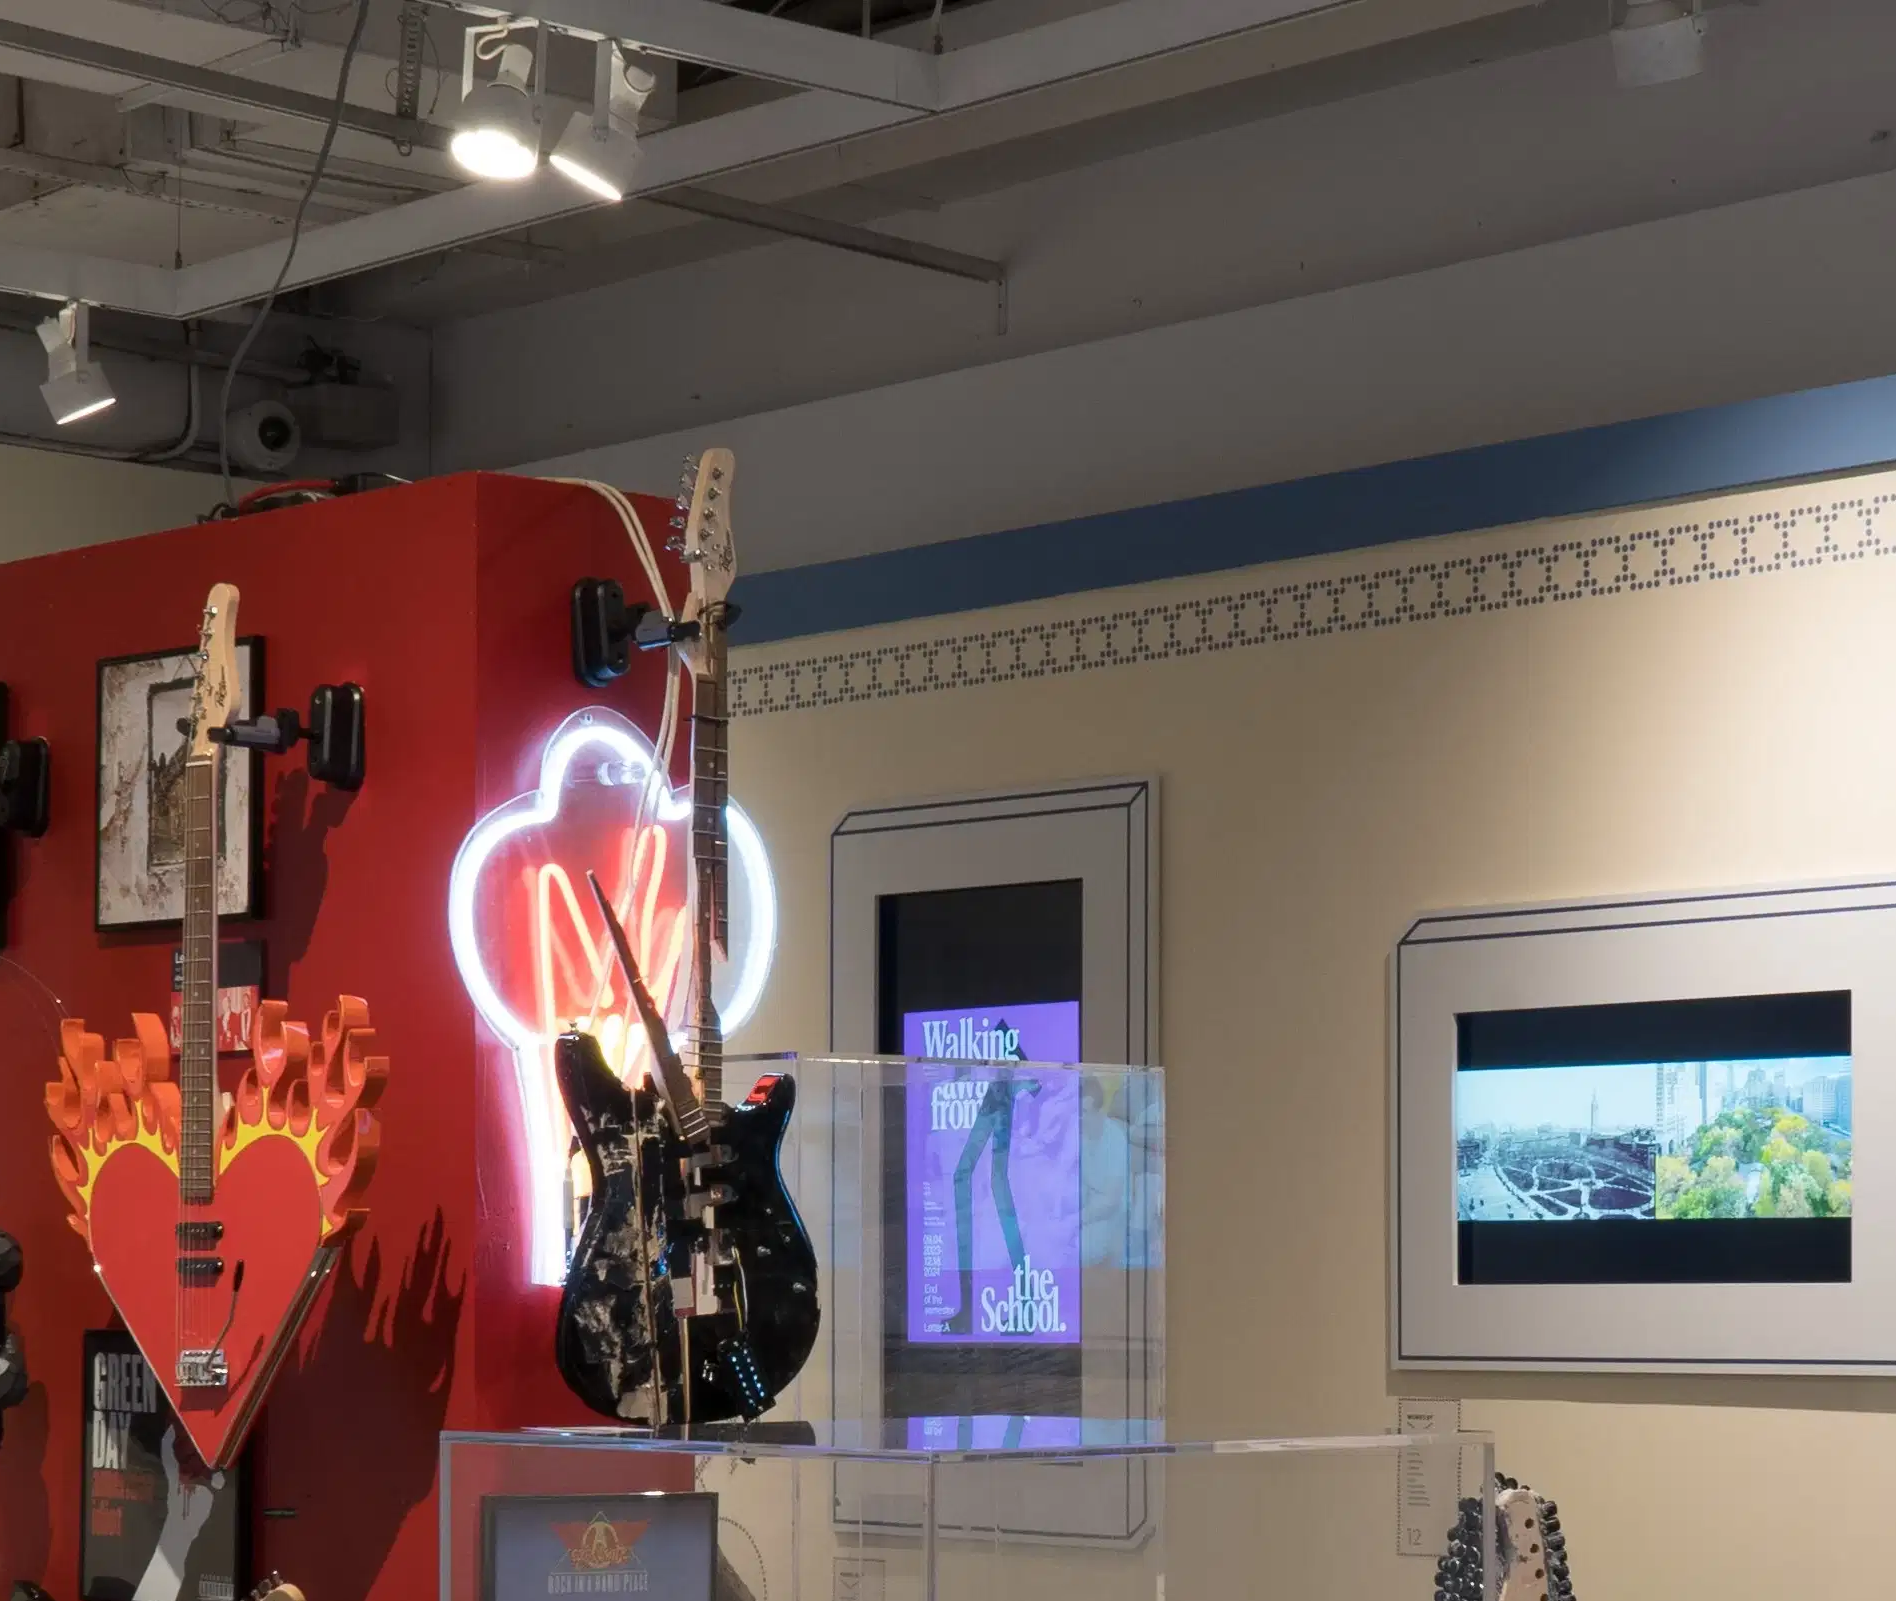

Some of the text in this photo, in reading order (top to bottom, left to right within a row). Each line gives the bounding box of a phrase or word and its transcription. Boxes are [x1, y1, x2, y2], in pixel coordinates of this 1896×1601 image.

[922, 1016, 1021, 1061] Walking
[1013, 1253, 1054, 1301] the
[981, 1285, 1067, 1334] School.
[92, 1351, 157, 1413] GREEN
[92, 1409, 132, 1470] DAY
[547, 1575, 573, 1594] ROCK
[574, 1575, 585, 1593] IN
[595, 1574, 621, 1593] HARD
[623, 1573, 648, 1593] PLACE
